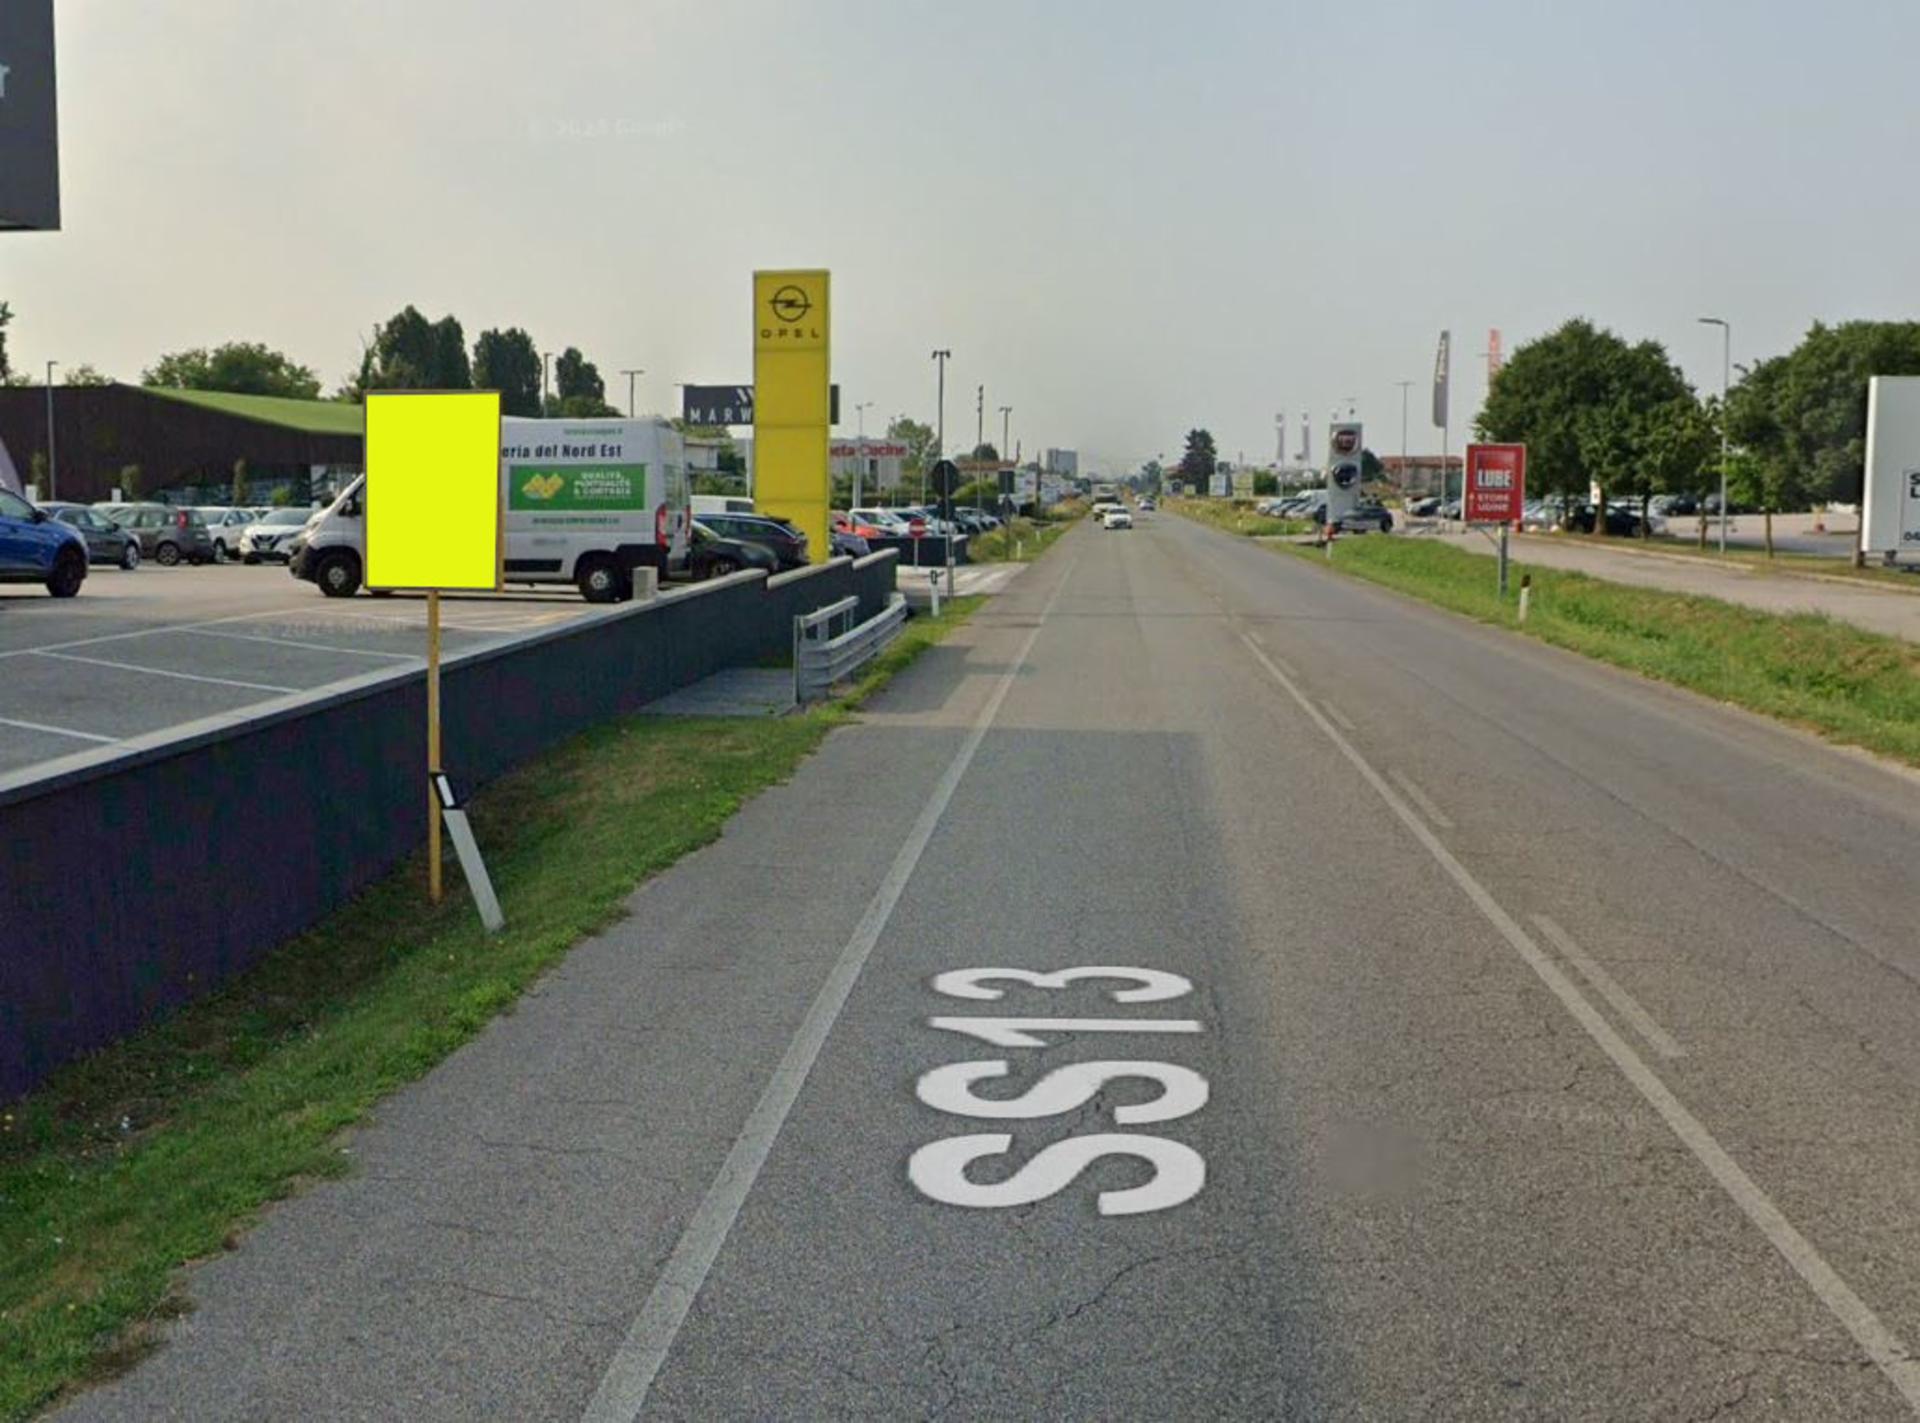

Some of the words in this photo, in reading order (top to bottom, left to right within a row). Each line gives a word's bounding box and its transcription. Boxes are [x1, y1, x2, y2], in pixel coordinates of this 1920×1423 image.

[761, 328, 820, 339] OPEL
[690, 406, 753, 424] MARW
[501, 444, 530, 458] eria
[535, 444, 558, 458] del
[562, 444, 596, 458] Nord
[600, 444, 622, 458] Est
[1477, 468, 1513, 488] LUBE
[908, 965, 1209, 1216] SS13
